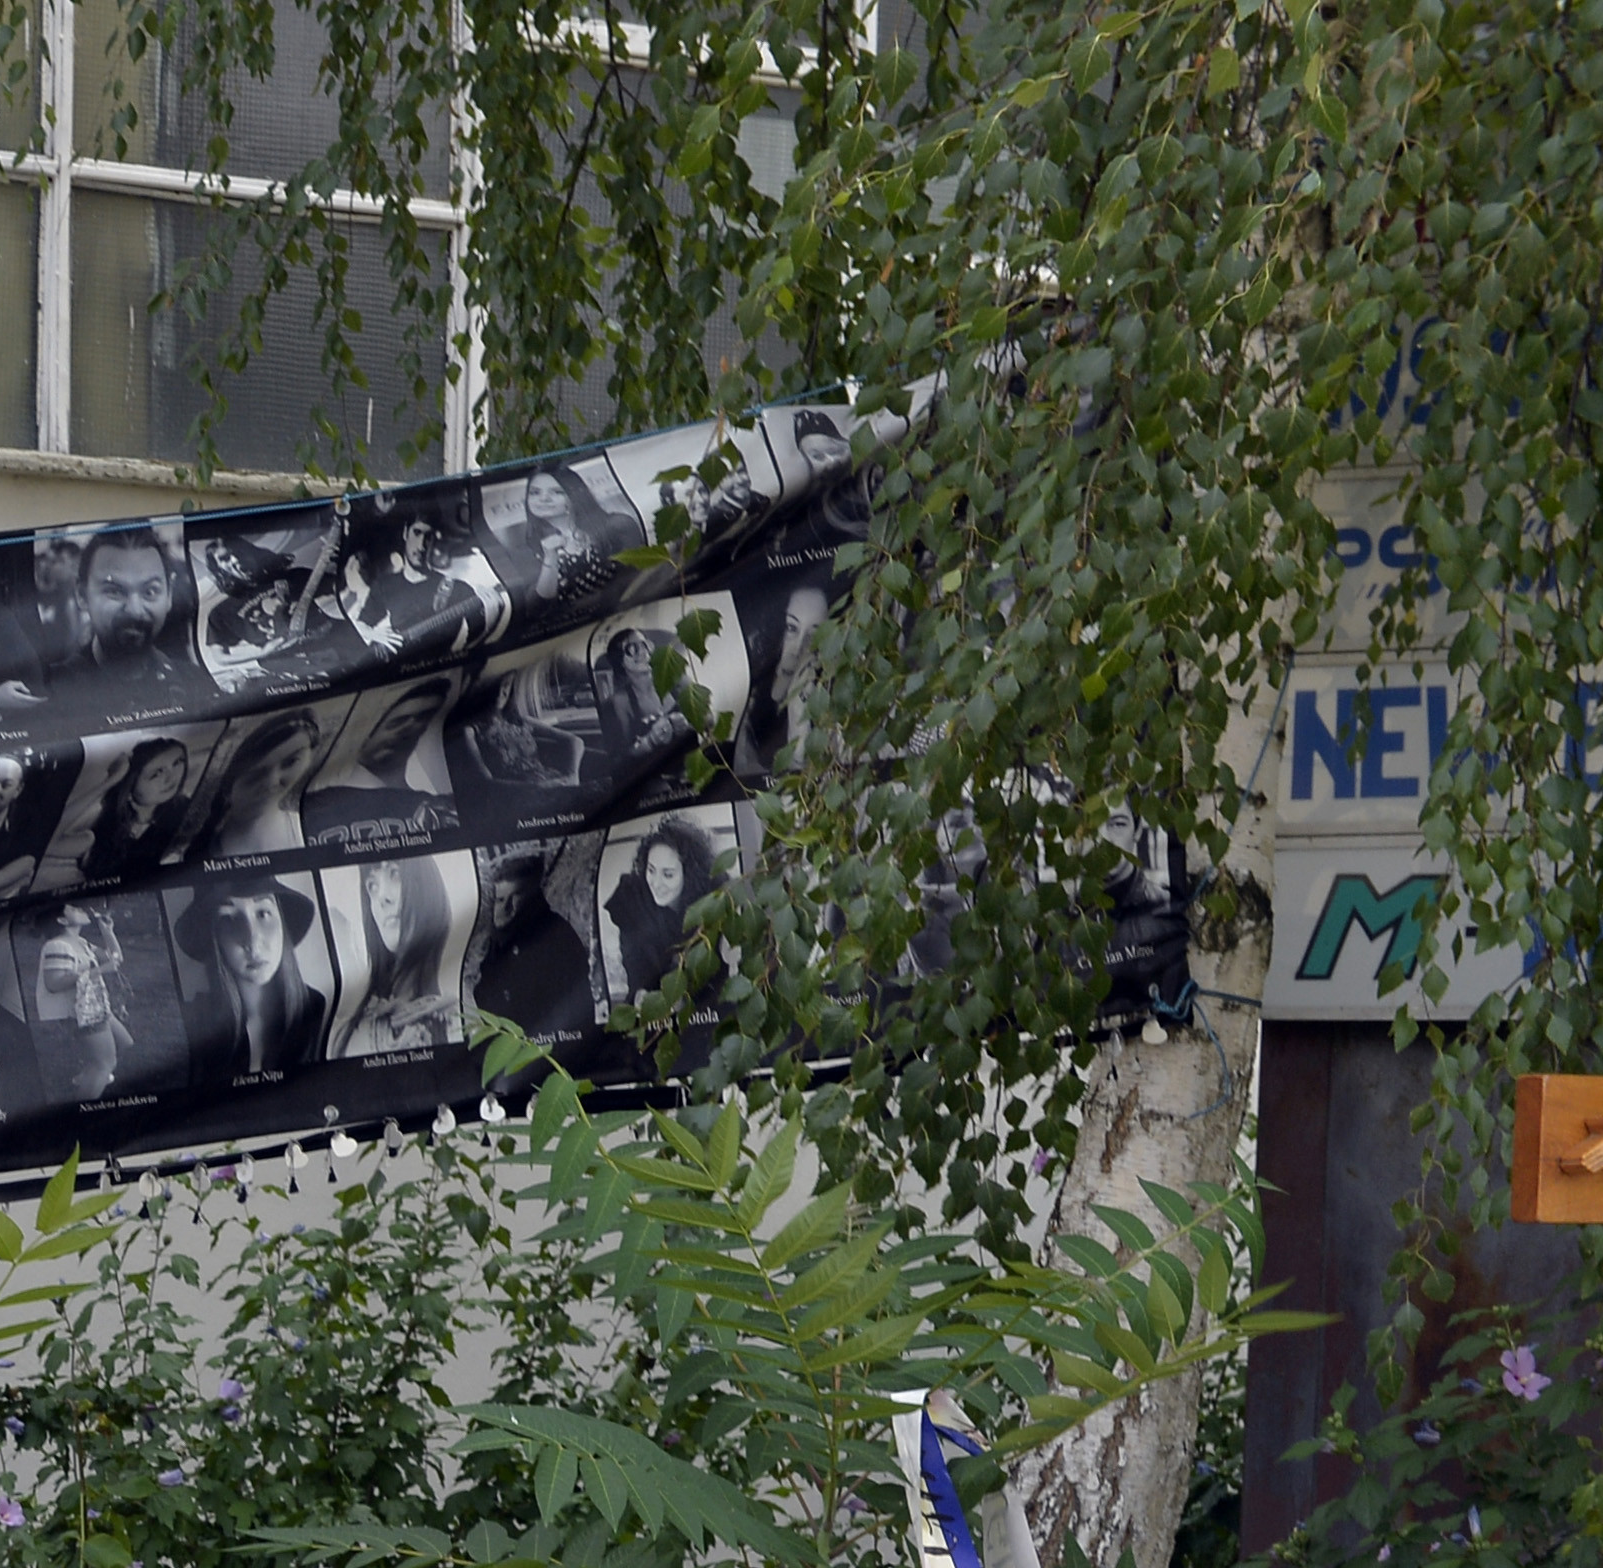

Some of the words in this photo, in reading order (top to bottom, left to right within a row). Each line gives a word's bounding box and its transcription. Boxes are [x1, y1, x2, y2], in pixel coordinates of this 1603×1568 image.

[767, 553, 803, 570] Mimi
[106, 713, 132, 726] Liviu
[134, 705, 185, 720] Zaharescu
[0, 728, 30, 742] Petre
[517, 817, 556, 829] Andreea
[343, 841, 373, 855] Andrei
[203, 860, 231, 873] Mavi
[233, 854, 271, 869] Serian
